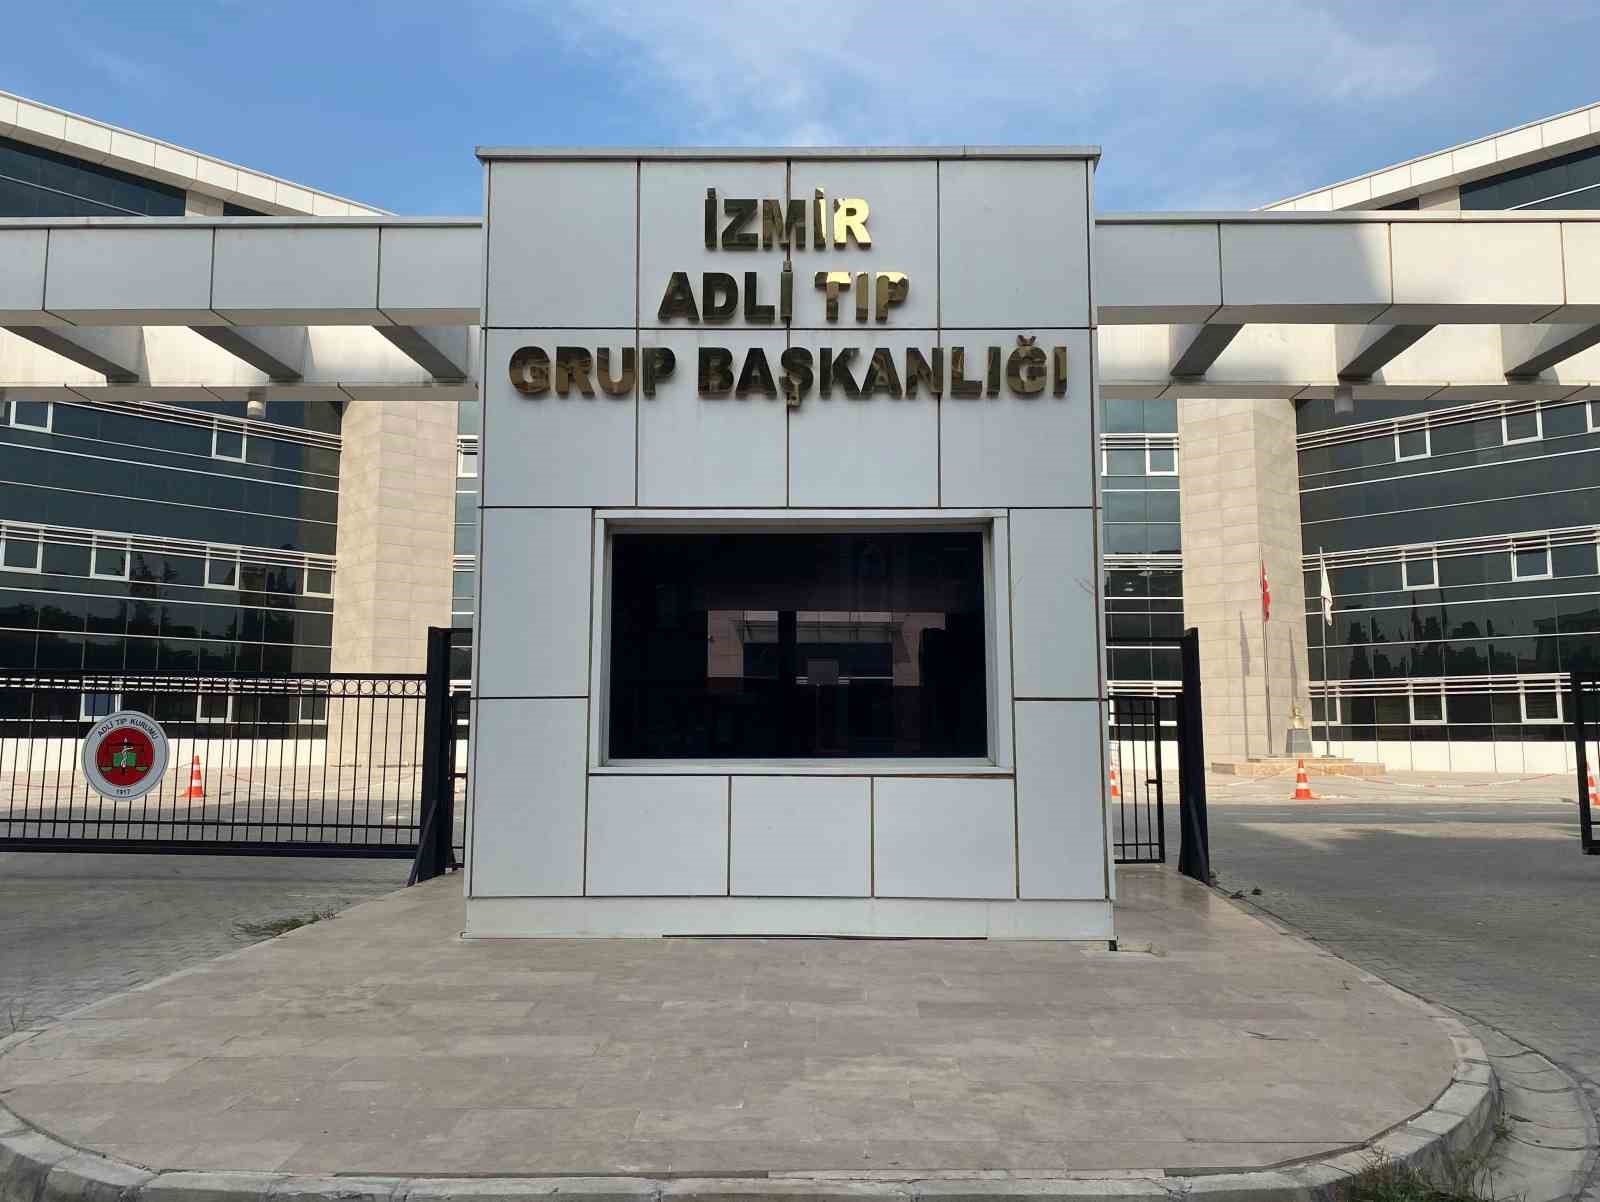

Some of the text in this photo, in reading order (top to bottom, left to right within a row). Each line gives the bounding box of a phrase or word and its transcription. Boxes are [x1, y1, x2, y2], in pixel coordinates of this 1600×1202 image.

[704, 187, 872, 250] İZMİR
[657, 260, 910, 322] ADLİ TIP
[508, 335, 1068, 409] GRUP BAŞKANLIĞI
